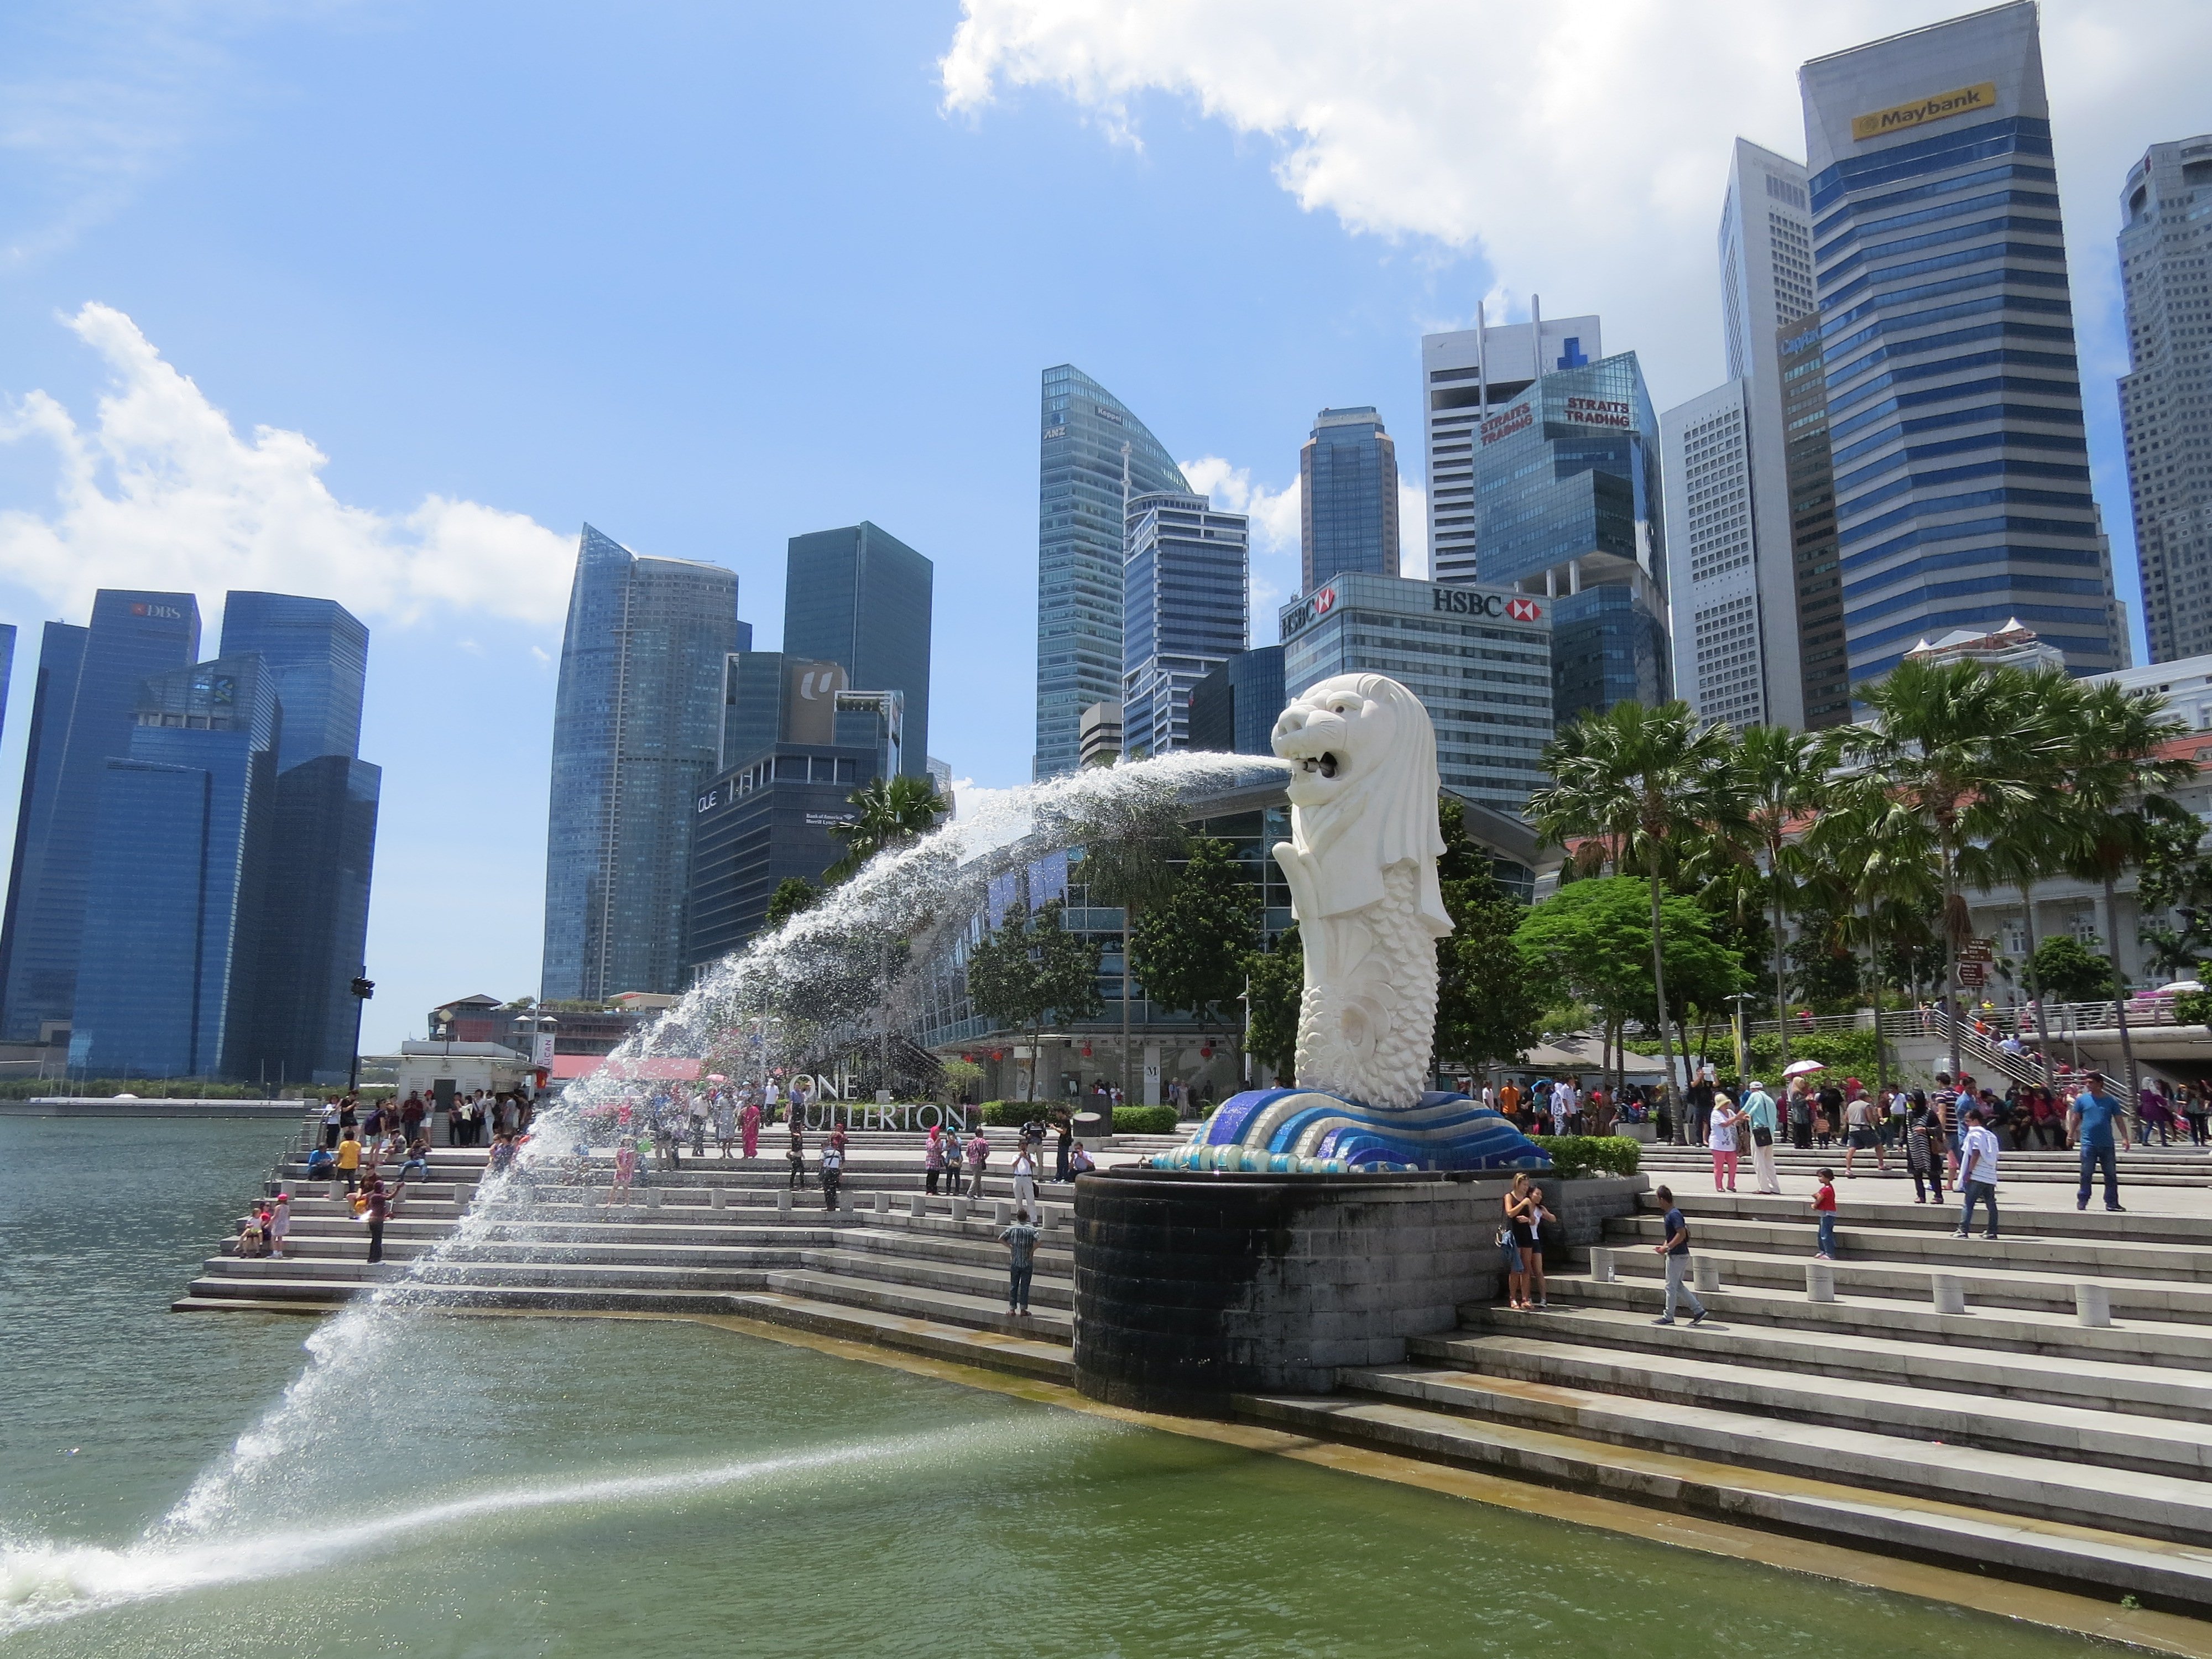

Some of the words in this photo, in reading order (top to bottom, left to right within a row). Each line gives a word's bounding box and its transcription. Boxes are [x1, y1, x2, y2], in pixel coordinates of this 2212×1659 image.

[1881, 90, 1981, 128] Maybank
[1098, 407, 1121, 422] Keppel
[1480, 402, 1530, 434] STRAITS
[1564, 410, 1630, 426] TRADING
[1568, 397, 1629, 414] STRAITS
[1044, 426, 1066, 440] ANZ
[1480, 414, 1533, 446] TRADING
[147, 604, 181, 619] DBS
[1433, 588, 1502, 618] HSBC
[1281, 598, 1314, 640] HSBC
[789, 1074, 858, 1100] ONE
[803, 1104, 967, 1130] ULLERTON
